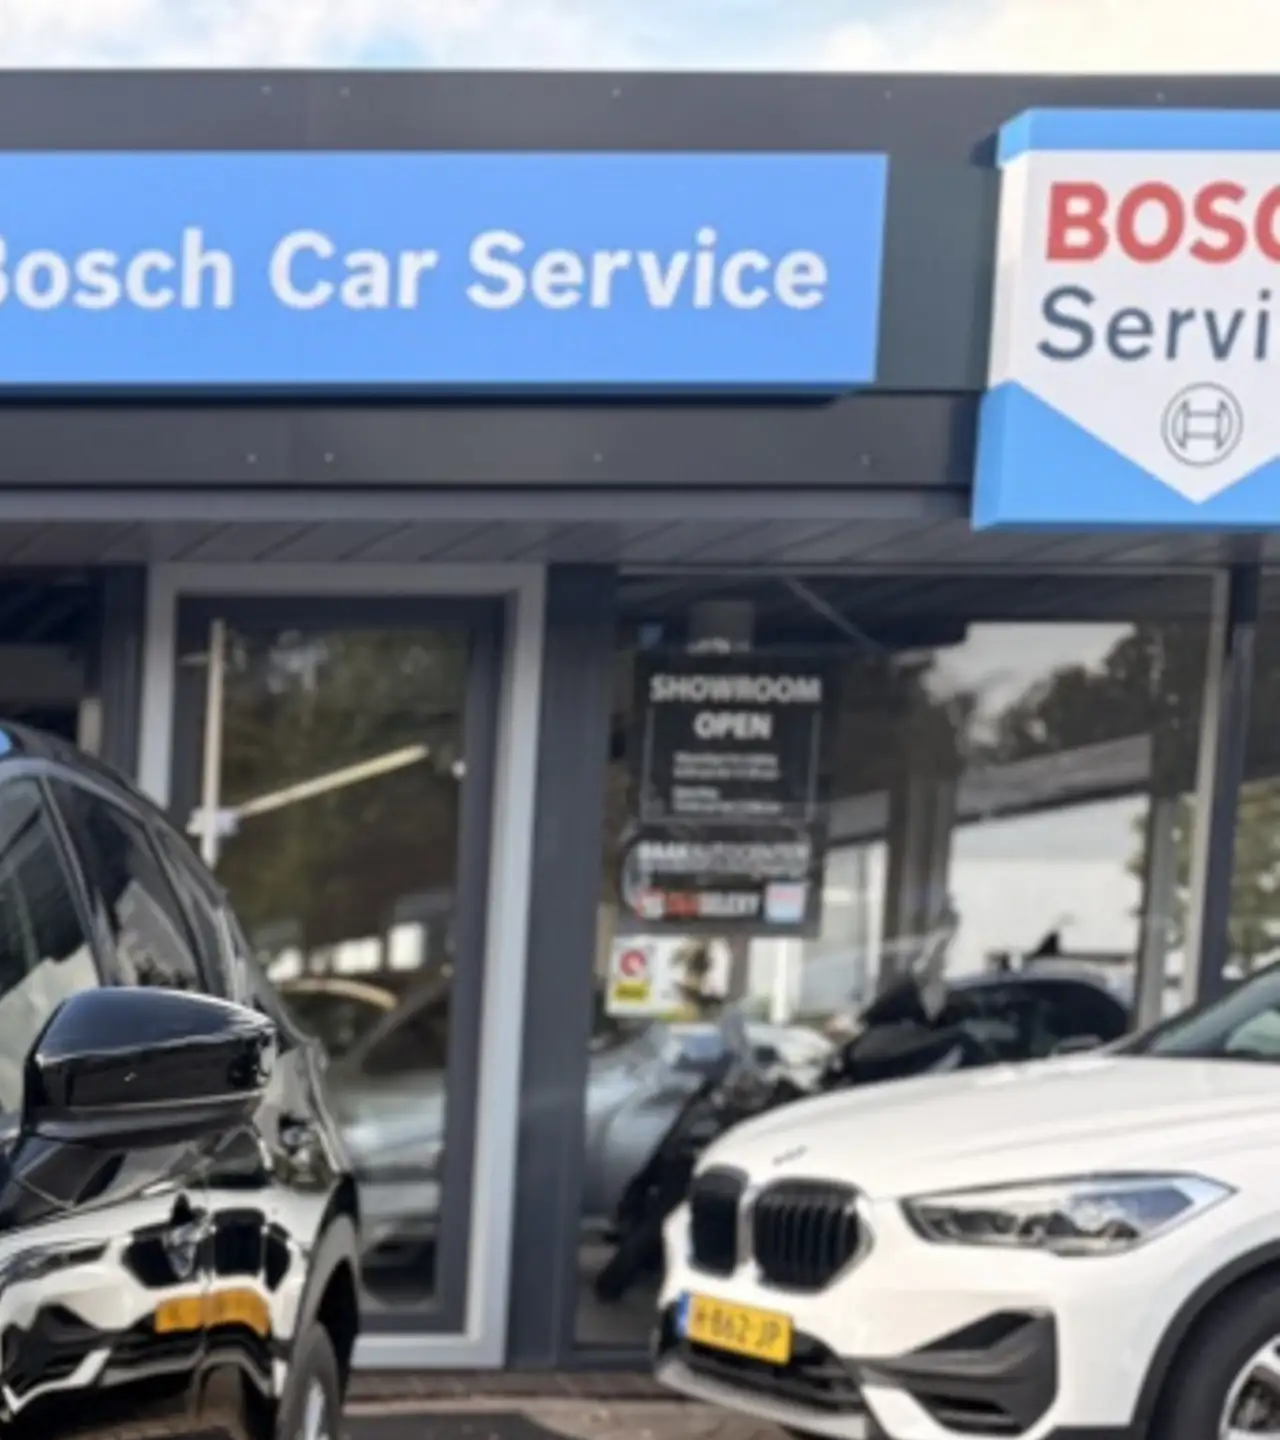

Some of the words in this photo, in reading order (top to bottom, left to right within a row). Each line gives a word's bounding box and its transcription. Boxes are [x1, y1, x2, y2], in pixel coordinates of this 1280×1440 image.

[269, 230, 438, 310] Car
[465, 226, 828, 310] Service
[1036, 284, 1272, 362] Servi
[650, 674, 822, 703] SHOWROOM
[693, 711, 773, 740] OPEN
